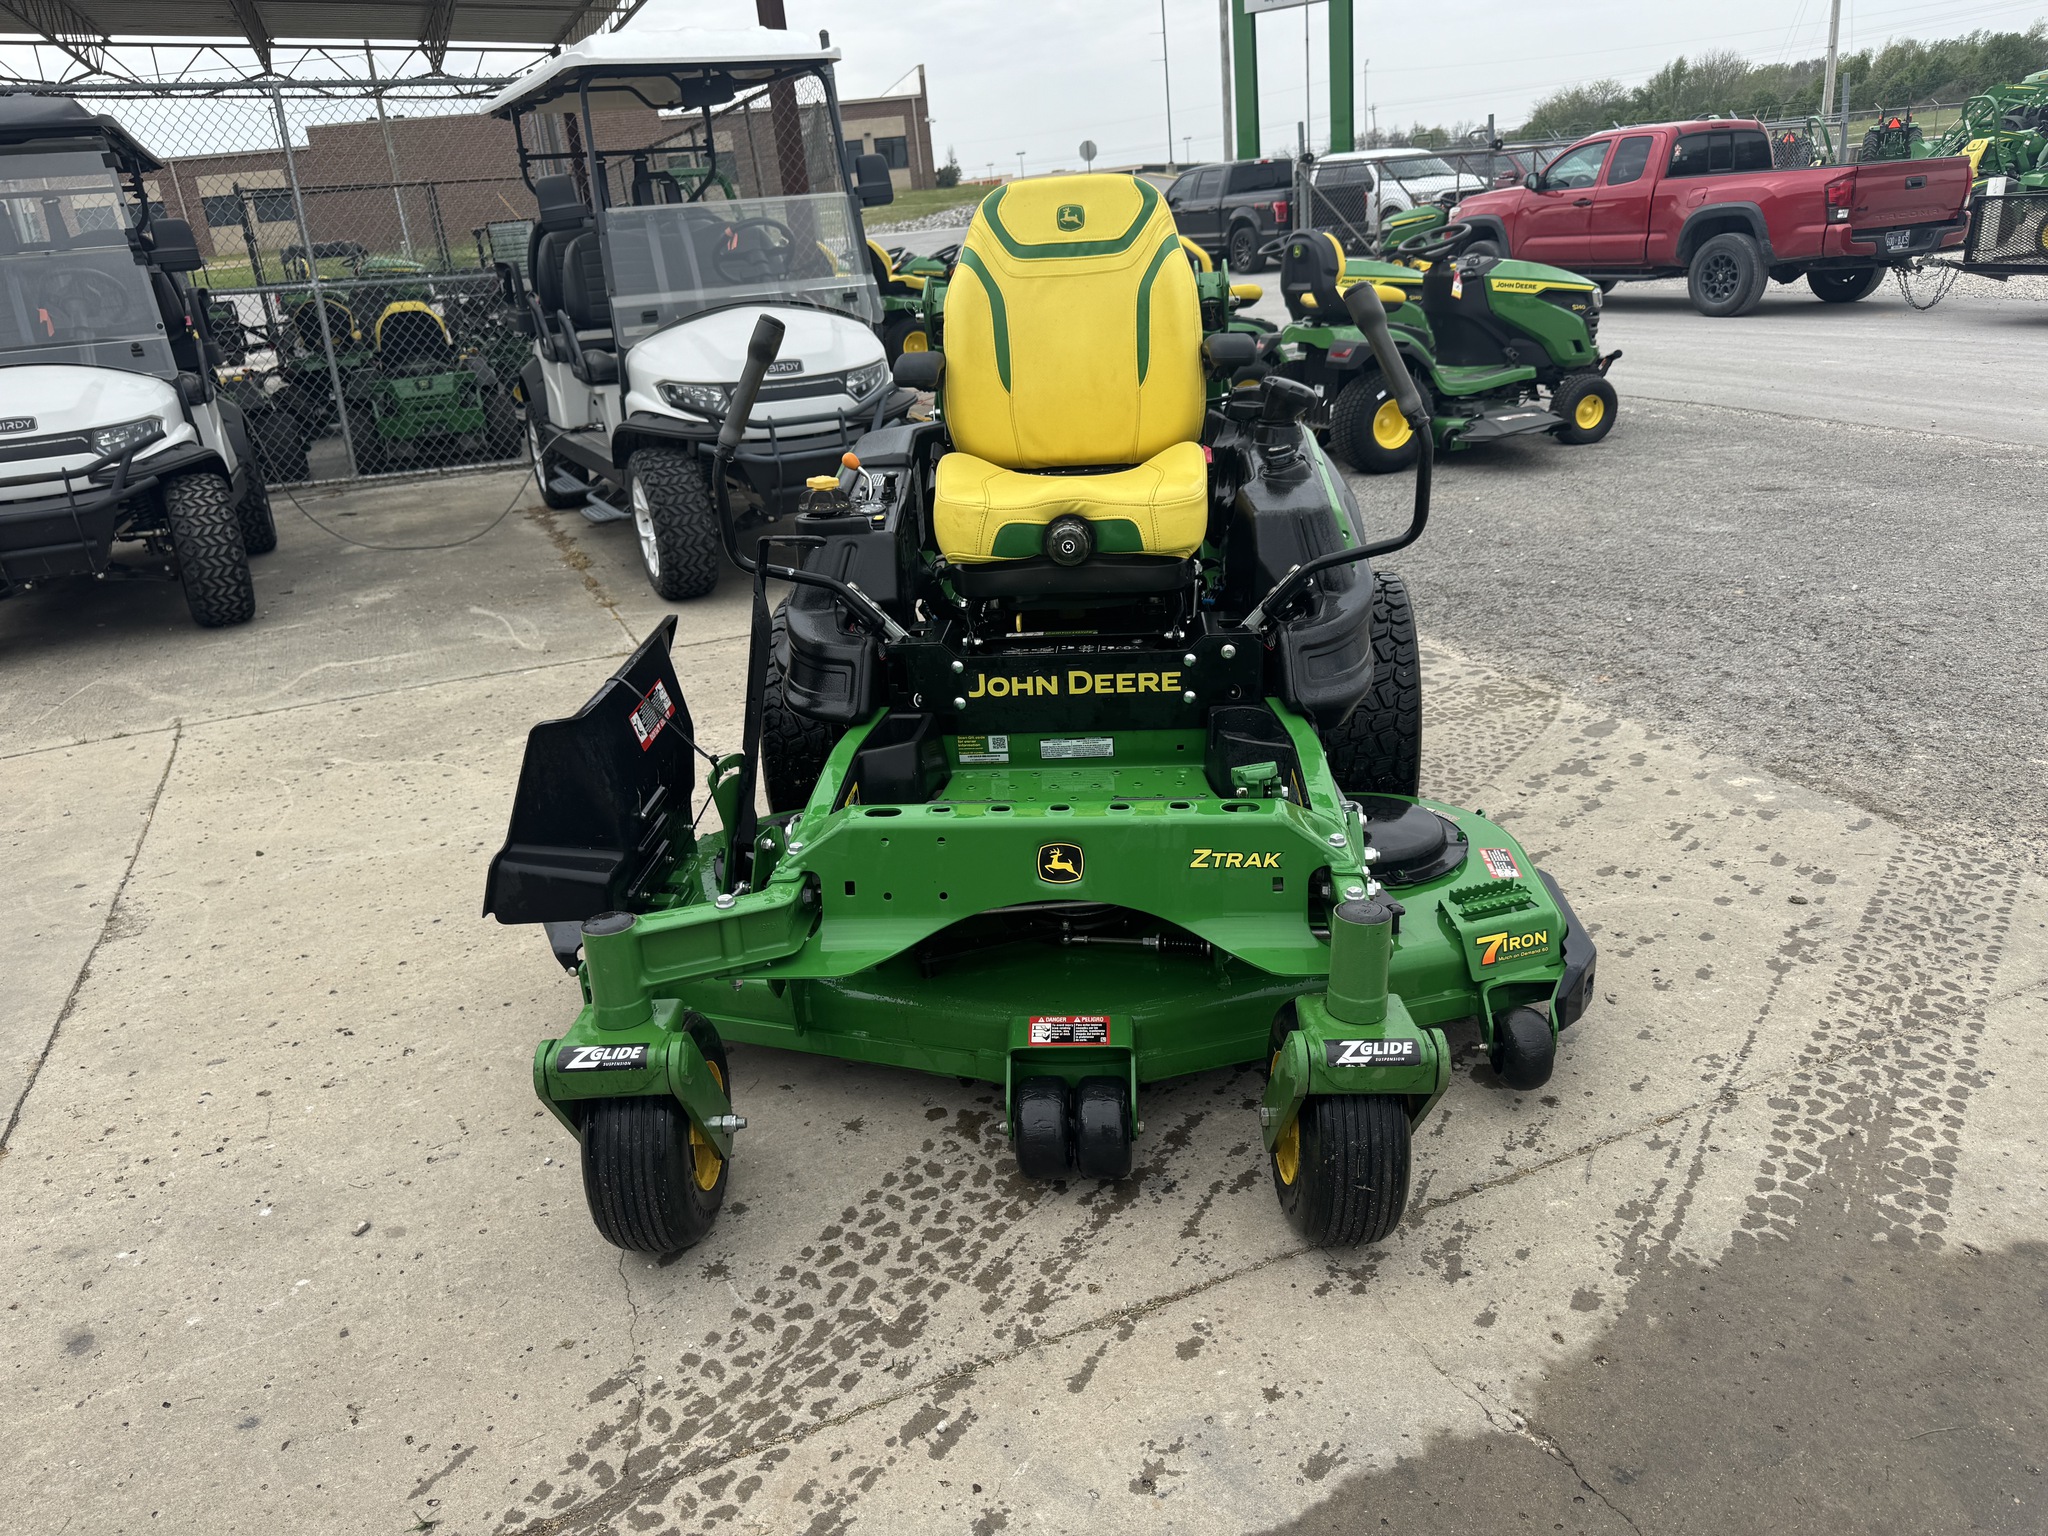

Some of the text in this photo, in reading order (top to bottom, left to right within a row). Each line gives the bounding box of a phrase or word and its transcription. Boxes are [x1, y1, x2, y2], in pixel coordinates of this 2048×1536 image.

[1875, 208, 1940, 220] TACOMA
[1496, 281, 1537, 290] JOHN DEERE
[0, 419, 31, 431] IRDY
[968, 670, 1182, 698] JOHN DEERE
[1189, 848, 1282, 868] ZTRAK
[1520, 949, 1541, 957] Demand
